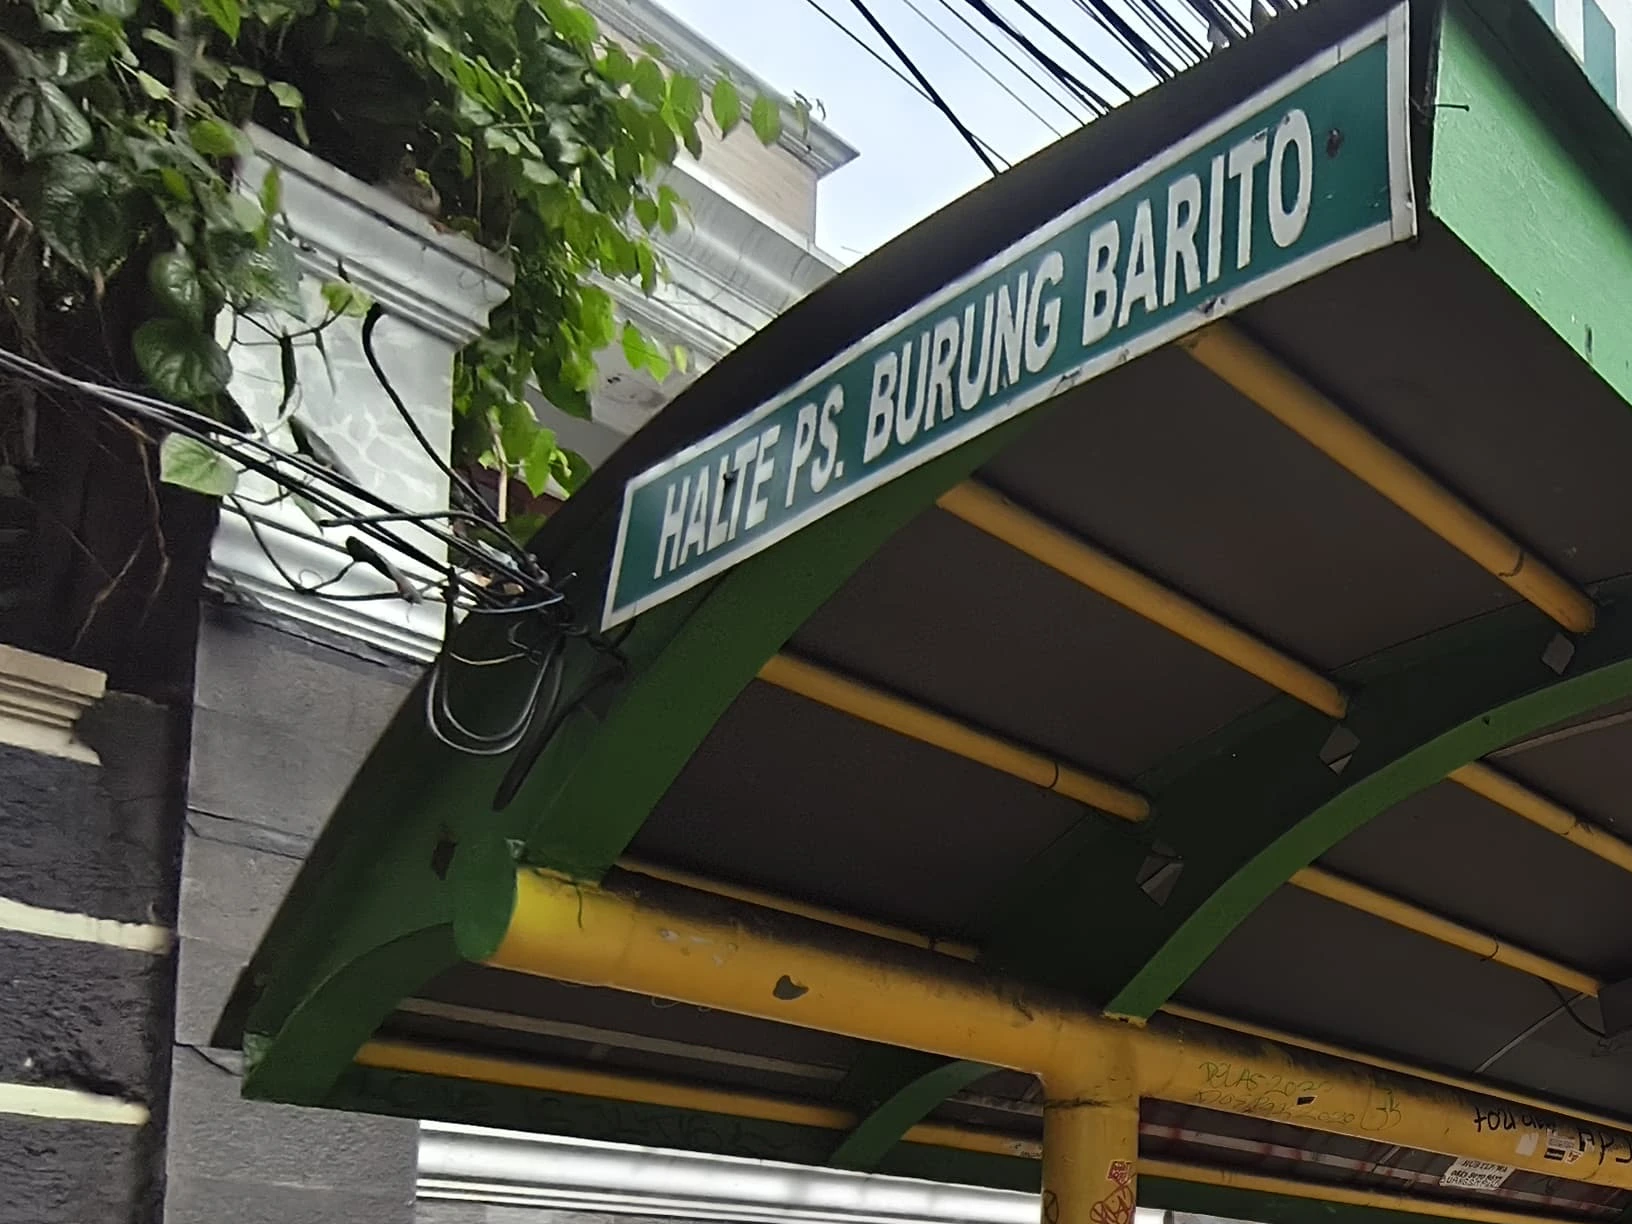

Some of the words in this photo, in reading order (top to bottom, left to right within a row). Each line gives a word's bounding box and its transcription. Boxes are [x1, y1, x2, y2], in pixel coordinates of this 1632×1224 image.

[654, 424, 781, 580] HALTE
[786, 382, 845, 510] PS.
[863, 251, 1065, 466] BURUNG
[1082, 108, 1314, 347] BARITO
